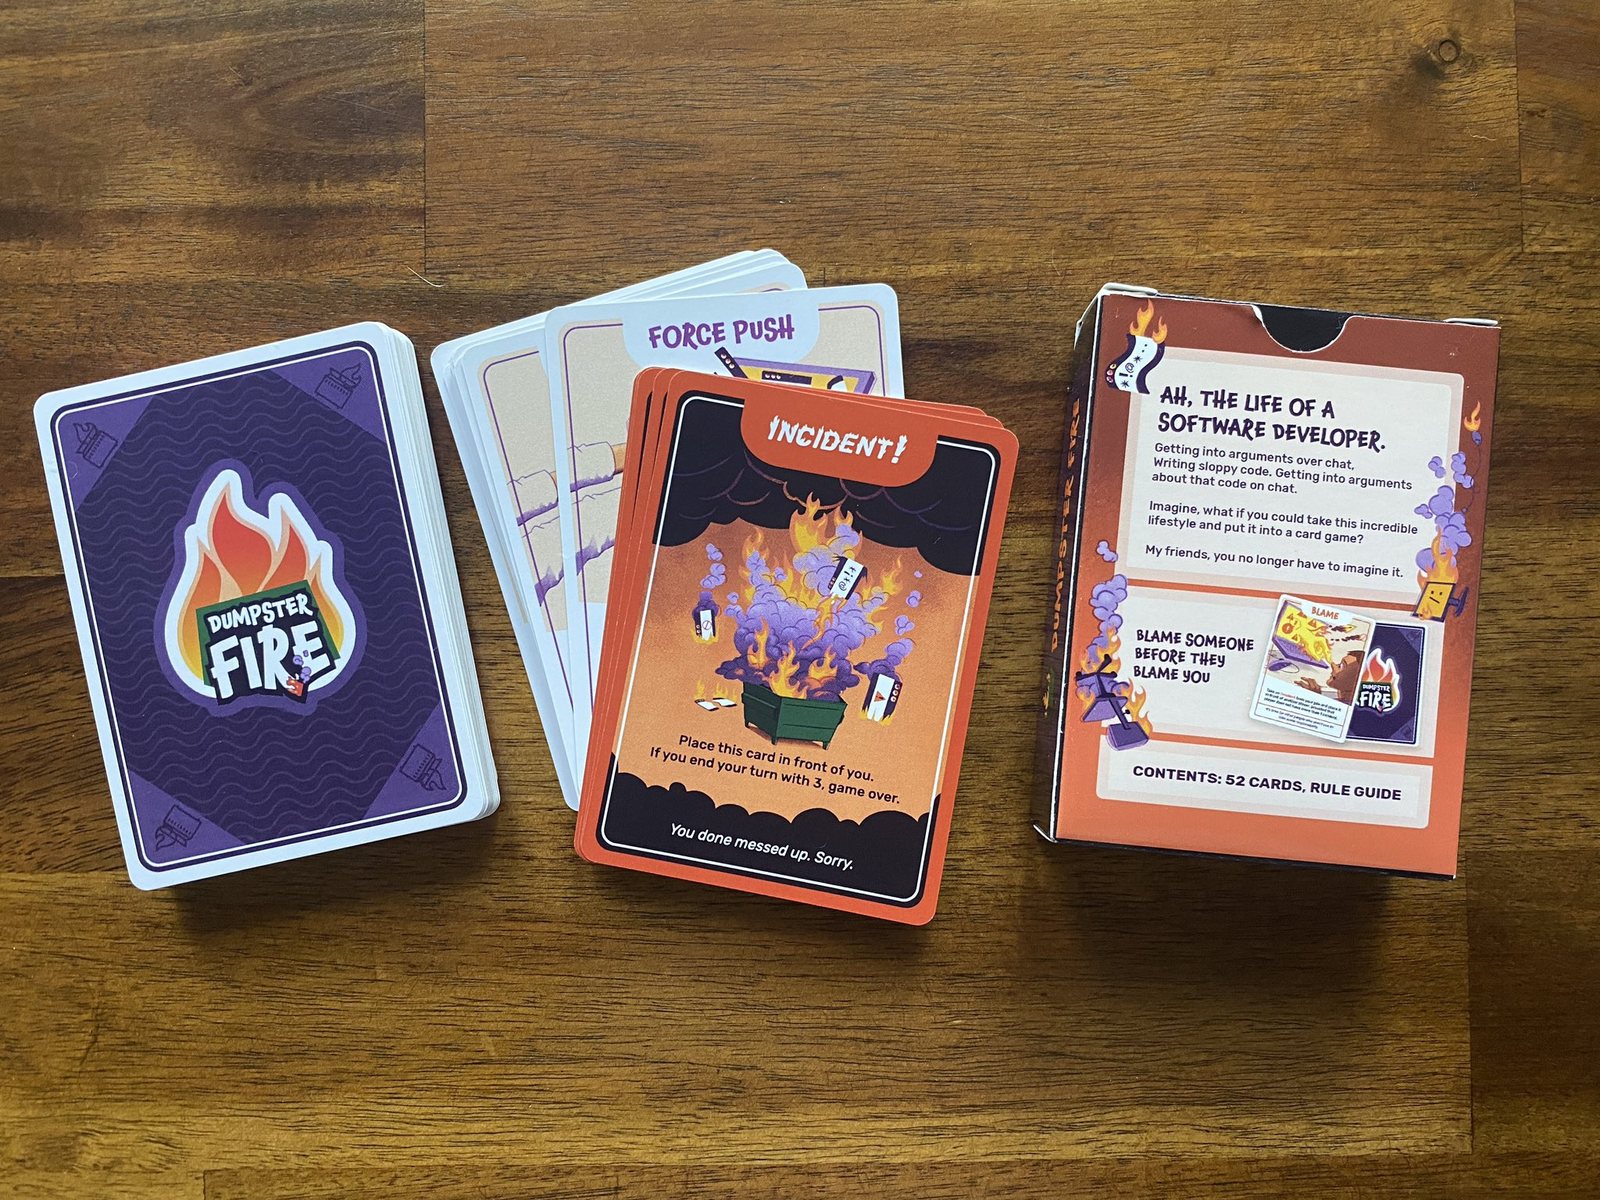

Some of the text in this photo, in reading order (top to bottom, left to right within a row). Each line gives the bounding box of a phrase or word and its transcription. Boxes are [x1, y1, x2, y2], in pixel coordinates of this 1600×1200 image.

[648, 314, 795, 350] FORCE PUSH
[1160, 386, 1335, 419] AH, THE LIFE OF A
[767, 415, 908, 464] INCIDENT!
[1158, 412, 1385, 453] SOFTWARE DEVELOPER.
[1155, 443, 1354, 470] Getting into arguments over chat,
[1152, 472, 1297, 493] about that code on chat.
[1154, 457, 1412, 490] Writing sloppy code. Getting into arguments
[1148, 515, 1196, 530] lifestyle
[1199, 521, 1221, 530] and
[1224, 524, 1245, 533] put
[1248, 524, 1256, 534] it
[1259, 525, 1282, 536] into
[1295, 531, 1321, 540] card
[1325, 533, 1364, 544] game?
[1150, 501, 1418, 534] Imagine, what if you could take this incredible
[1051, 475, 1074, 652] DUMPSTER
[1146, 545, 1403, 577] My friends, you no longer have to imagine it.
[207, 593, 314, 634] DUMPSTER
[1311, 606, 1339, 619] BLAME
[1137, 629, 1254, 651] BLAME SOMEONE
[209, 620, 331, 699] FIRE
[1134, 665, 1210, 683] BLAME YOU
[1135, 647, 1225, 668] BEFORE THEY
[1360, 691, 1391, 708] FIRE
[679, 735, 874, 782] Place this card in front of you.
[650, 747, 899, 804] If you end your turn with 3, game over.
[1133, 766, 1401, 800] CONTENTS: 52 CARDS, RULE GUIDE
[672, 823, 853, 871] You done messed up. Sorry.
